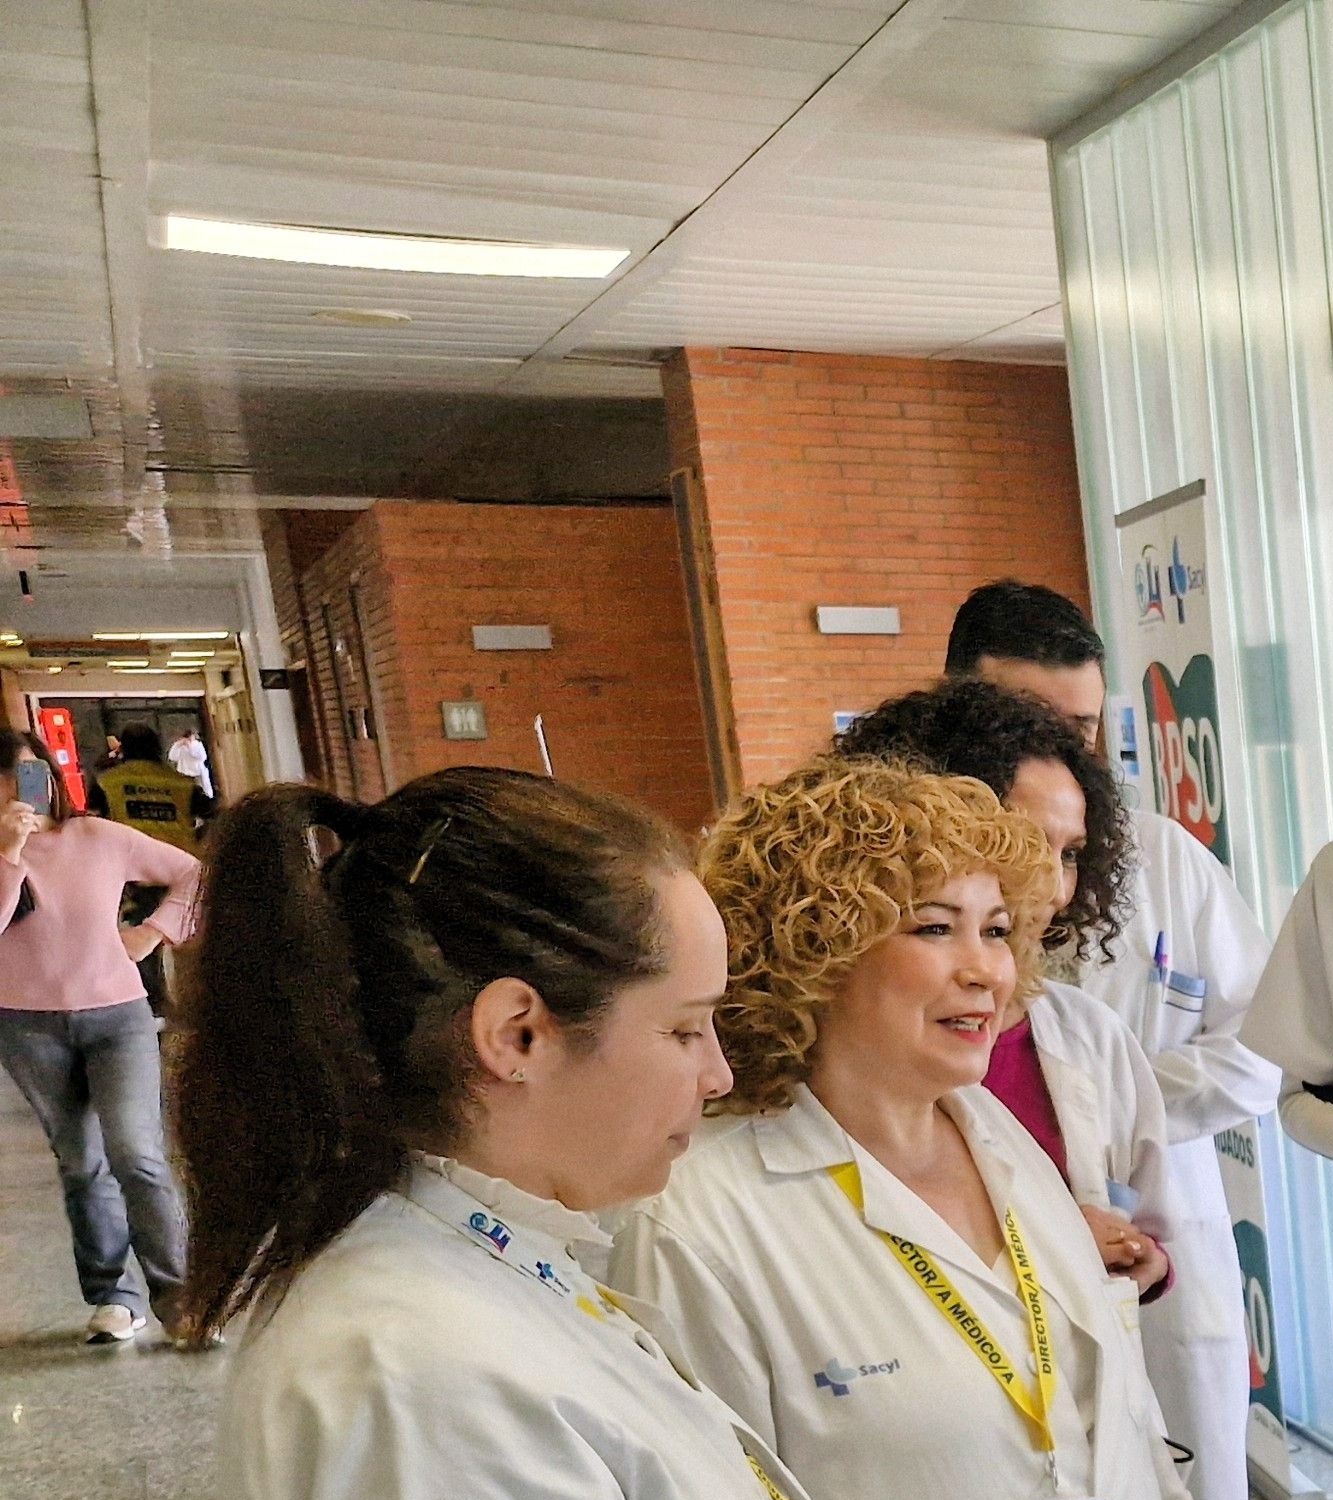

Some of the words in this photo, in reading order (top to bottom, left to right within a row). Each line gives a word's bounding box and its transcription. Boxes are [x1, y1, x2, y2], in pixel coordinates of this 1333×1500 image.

[1152, 717, 1221, 823] BPSO
[889, 1234, 952, 1304] ECTOR/A
[948, 1303, 1015, 1385] MÉDICO/A
[1021, 1273, 1052, 1375] DIRECTOR/A
[860, 1359, 900, 1377] Sacyl
